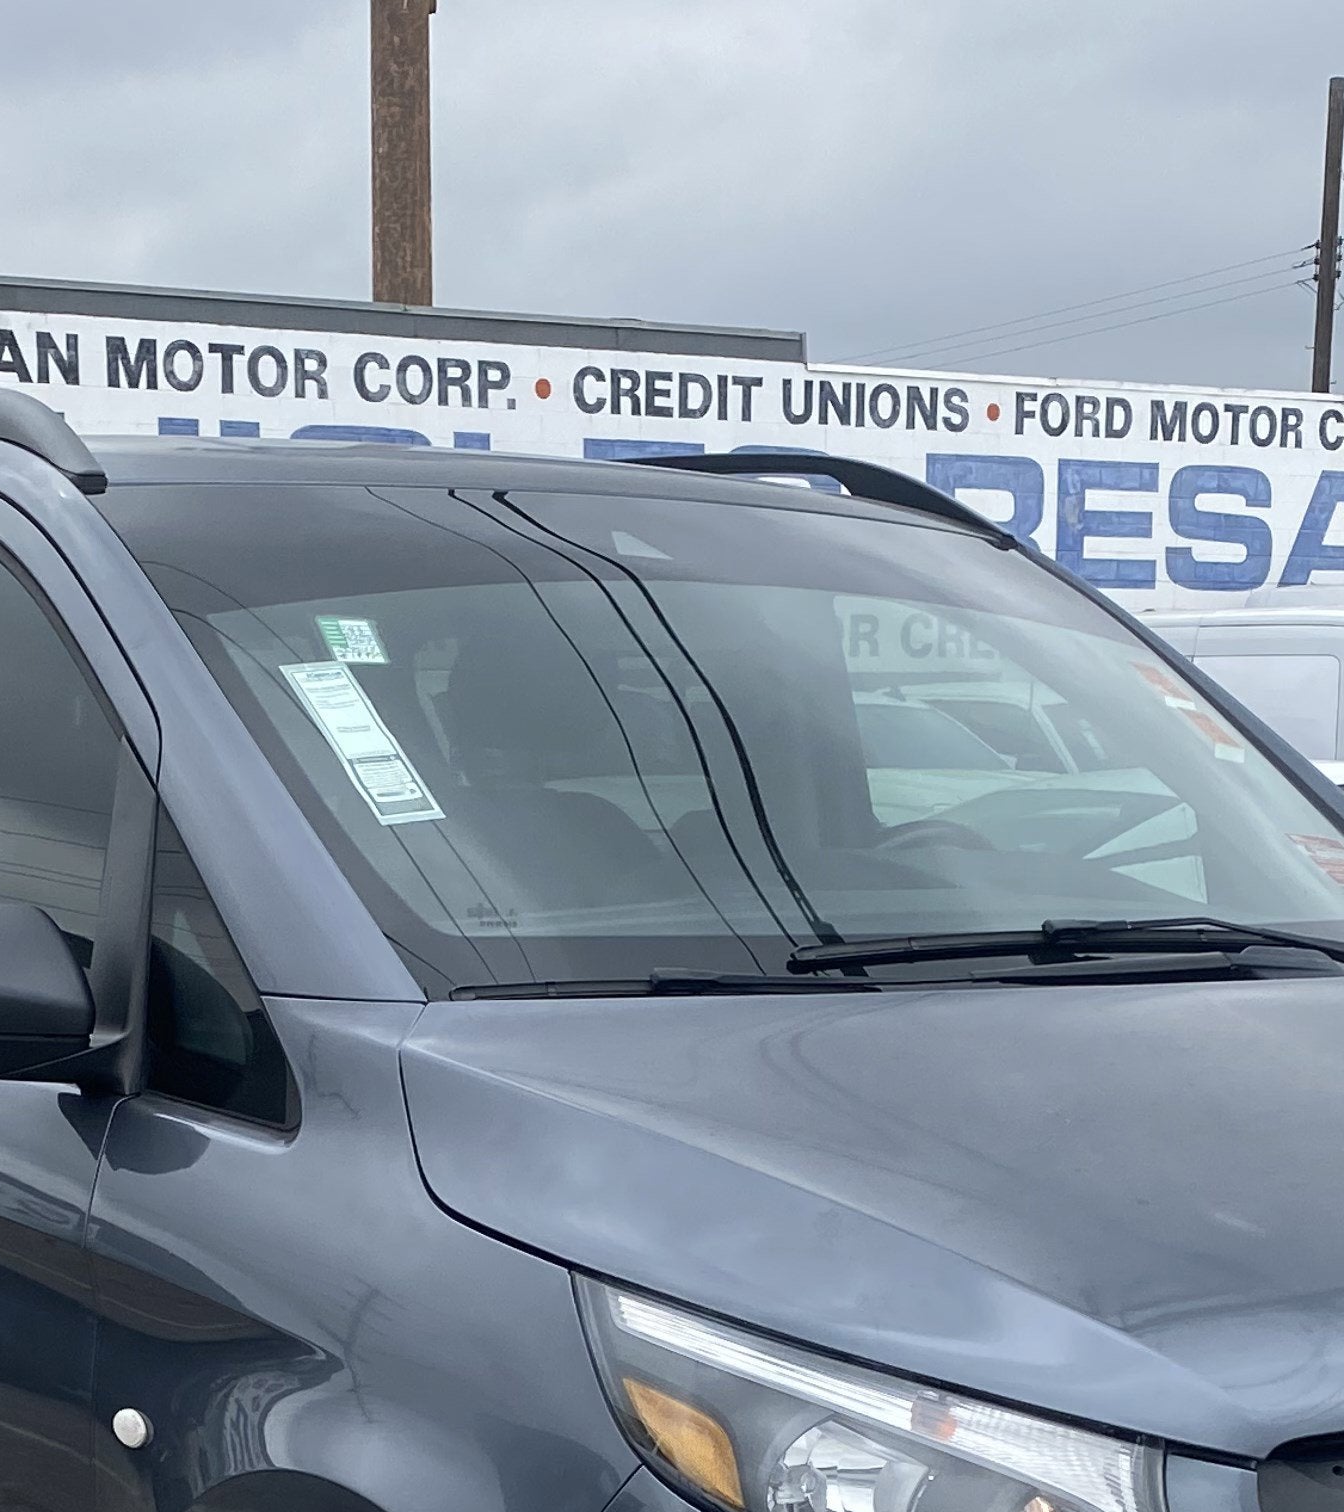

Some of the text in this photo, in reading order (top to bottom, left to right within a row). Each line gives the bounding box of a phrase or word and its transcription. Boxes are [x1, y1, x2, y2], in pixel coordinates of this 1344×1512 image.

[106, 336, 328, 399] MOTOR
[353, 352, 517, 410] CORP.
[573, 366, 763, 422] CREDIT
[782, 378, 970, 432] UNIONS
[1014, 391, 1133, 439] FORD
[1150, 401, 1304, 449] MOTOR
